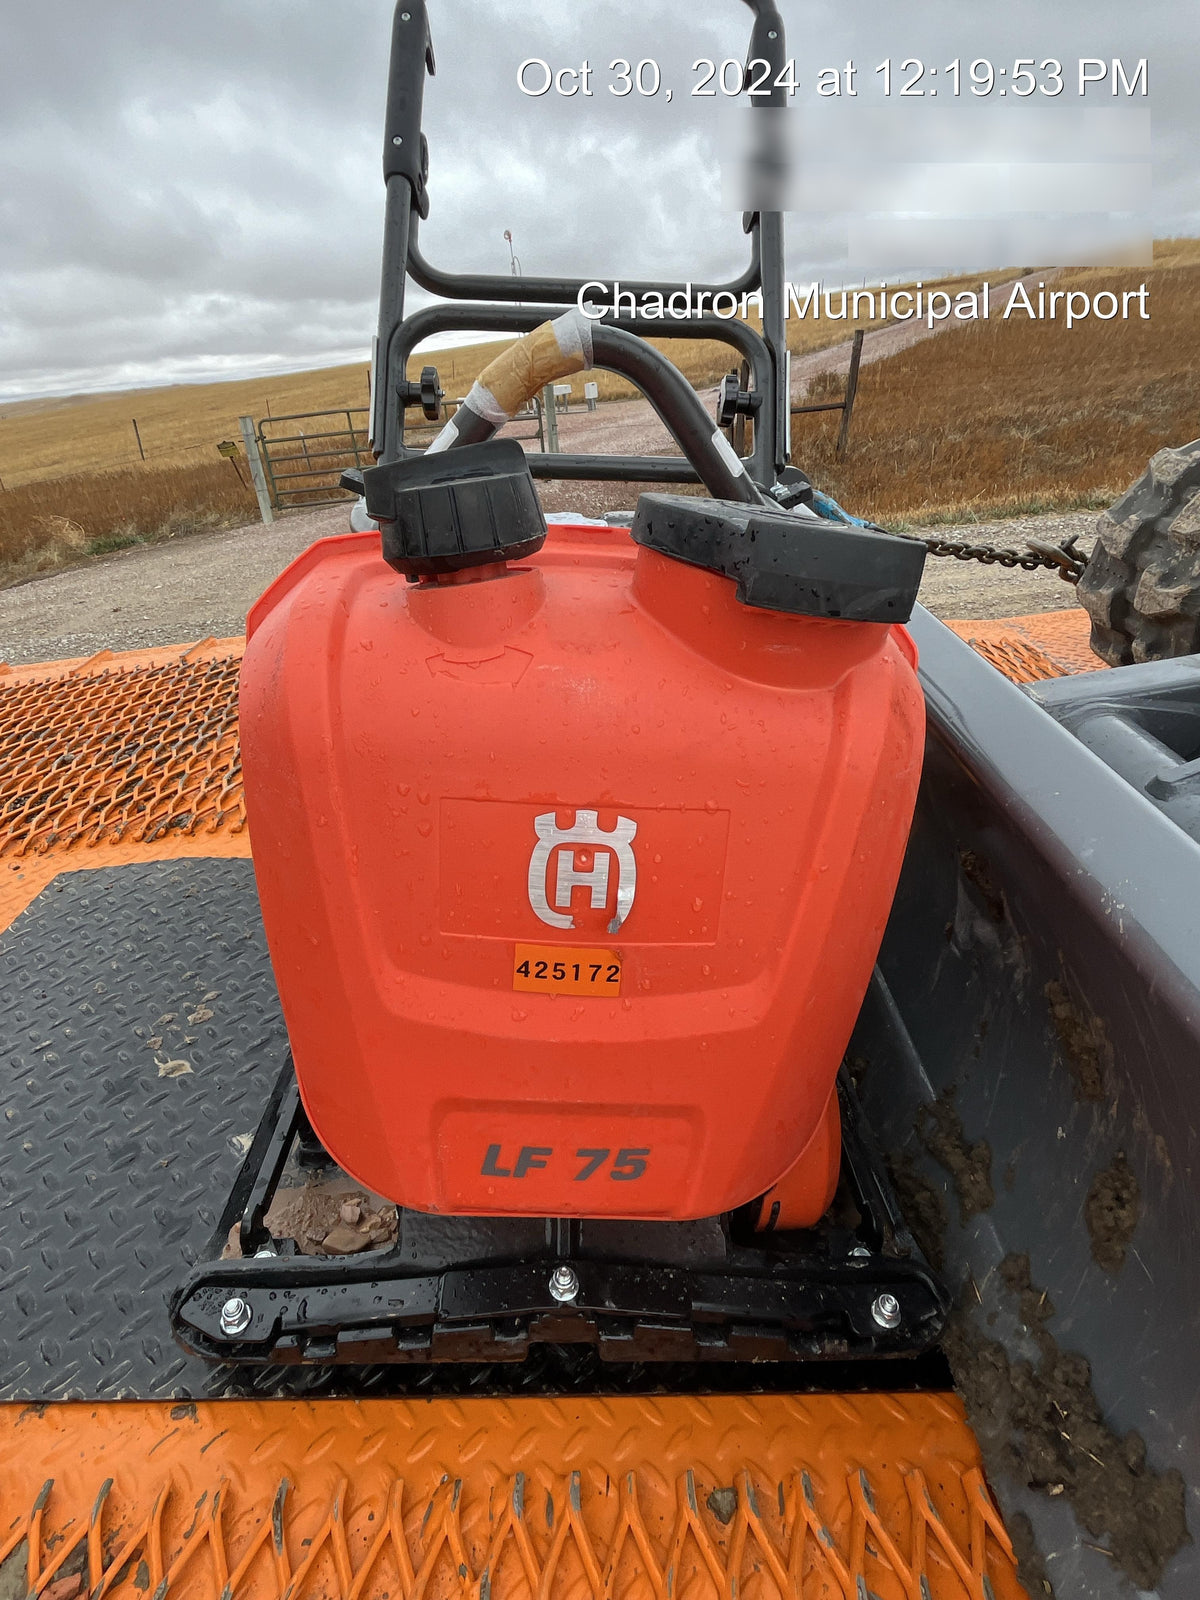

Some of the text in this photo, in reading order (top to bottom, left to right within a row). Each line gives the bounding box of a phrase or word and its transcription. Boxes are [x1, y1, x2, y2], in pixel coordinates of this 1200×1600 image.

[515, 960, 621, 983] 425172
[480, 1144, 651, 1181] LF 75
